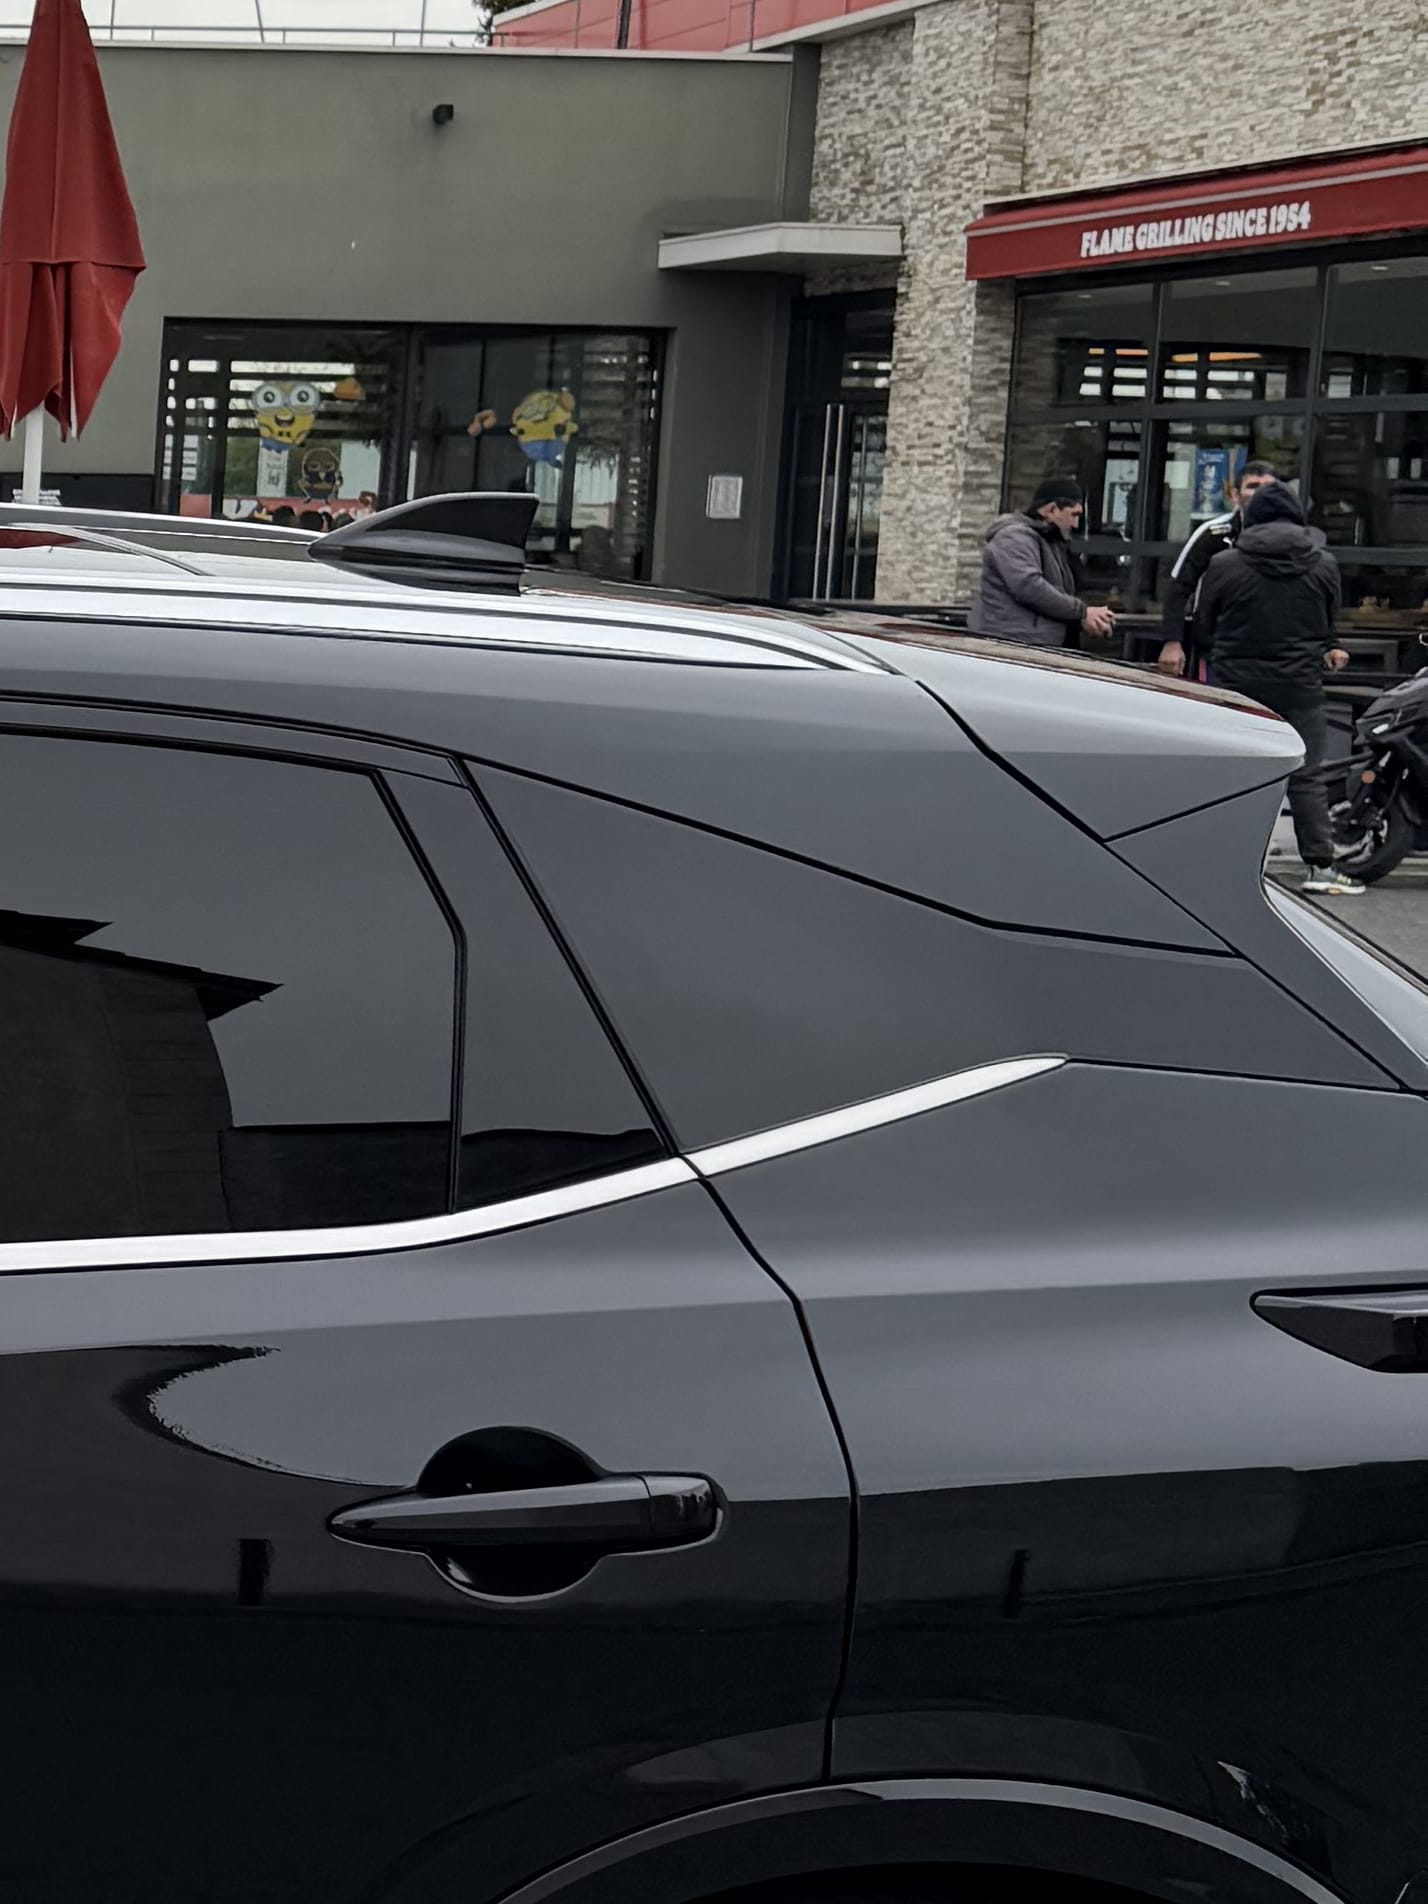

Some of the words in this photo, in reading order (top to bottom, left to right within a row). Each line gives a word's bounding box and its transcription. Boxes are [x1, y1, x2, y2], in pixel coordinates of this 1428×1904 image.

[1080, 225, 1135, 258] FLAME
[1135, 213, 1216, 251] GRILLING
[1215, 207, 1268, 241] SINCE
[1268, 201, 1312, 234] 1954
